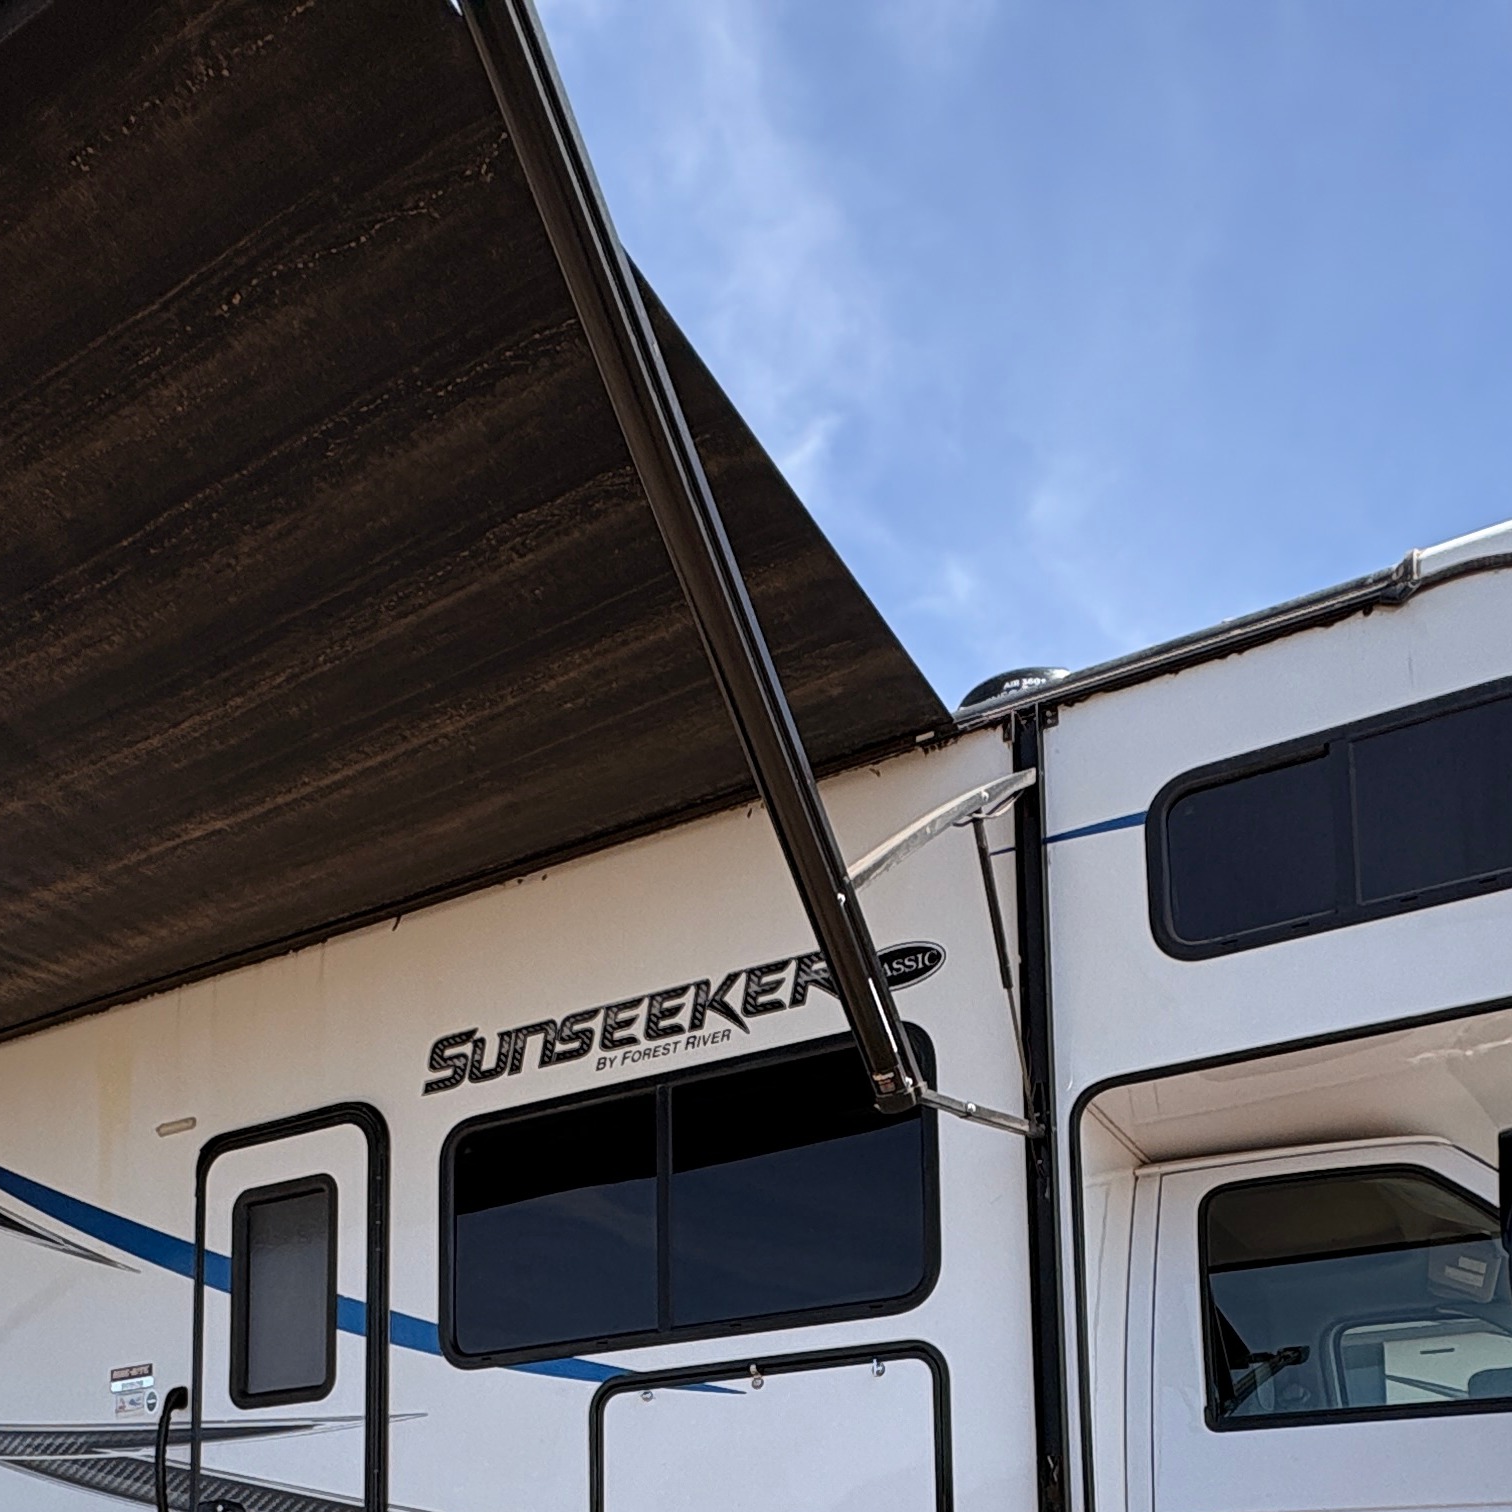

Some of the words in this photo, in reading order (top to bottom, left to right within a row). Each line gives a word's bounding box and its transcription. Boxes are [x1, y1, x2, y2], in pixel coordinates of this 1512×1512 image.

[1003, 680, 1020, 690] AIR
[595, 1055, 618, 1072] BY
[620, 1040, 682, 1066] FOREST
[684, 1029, 732, 1051] RIVER
